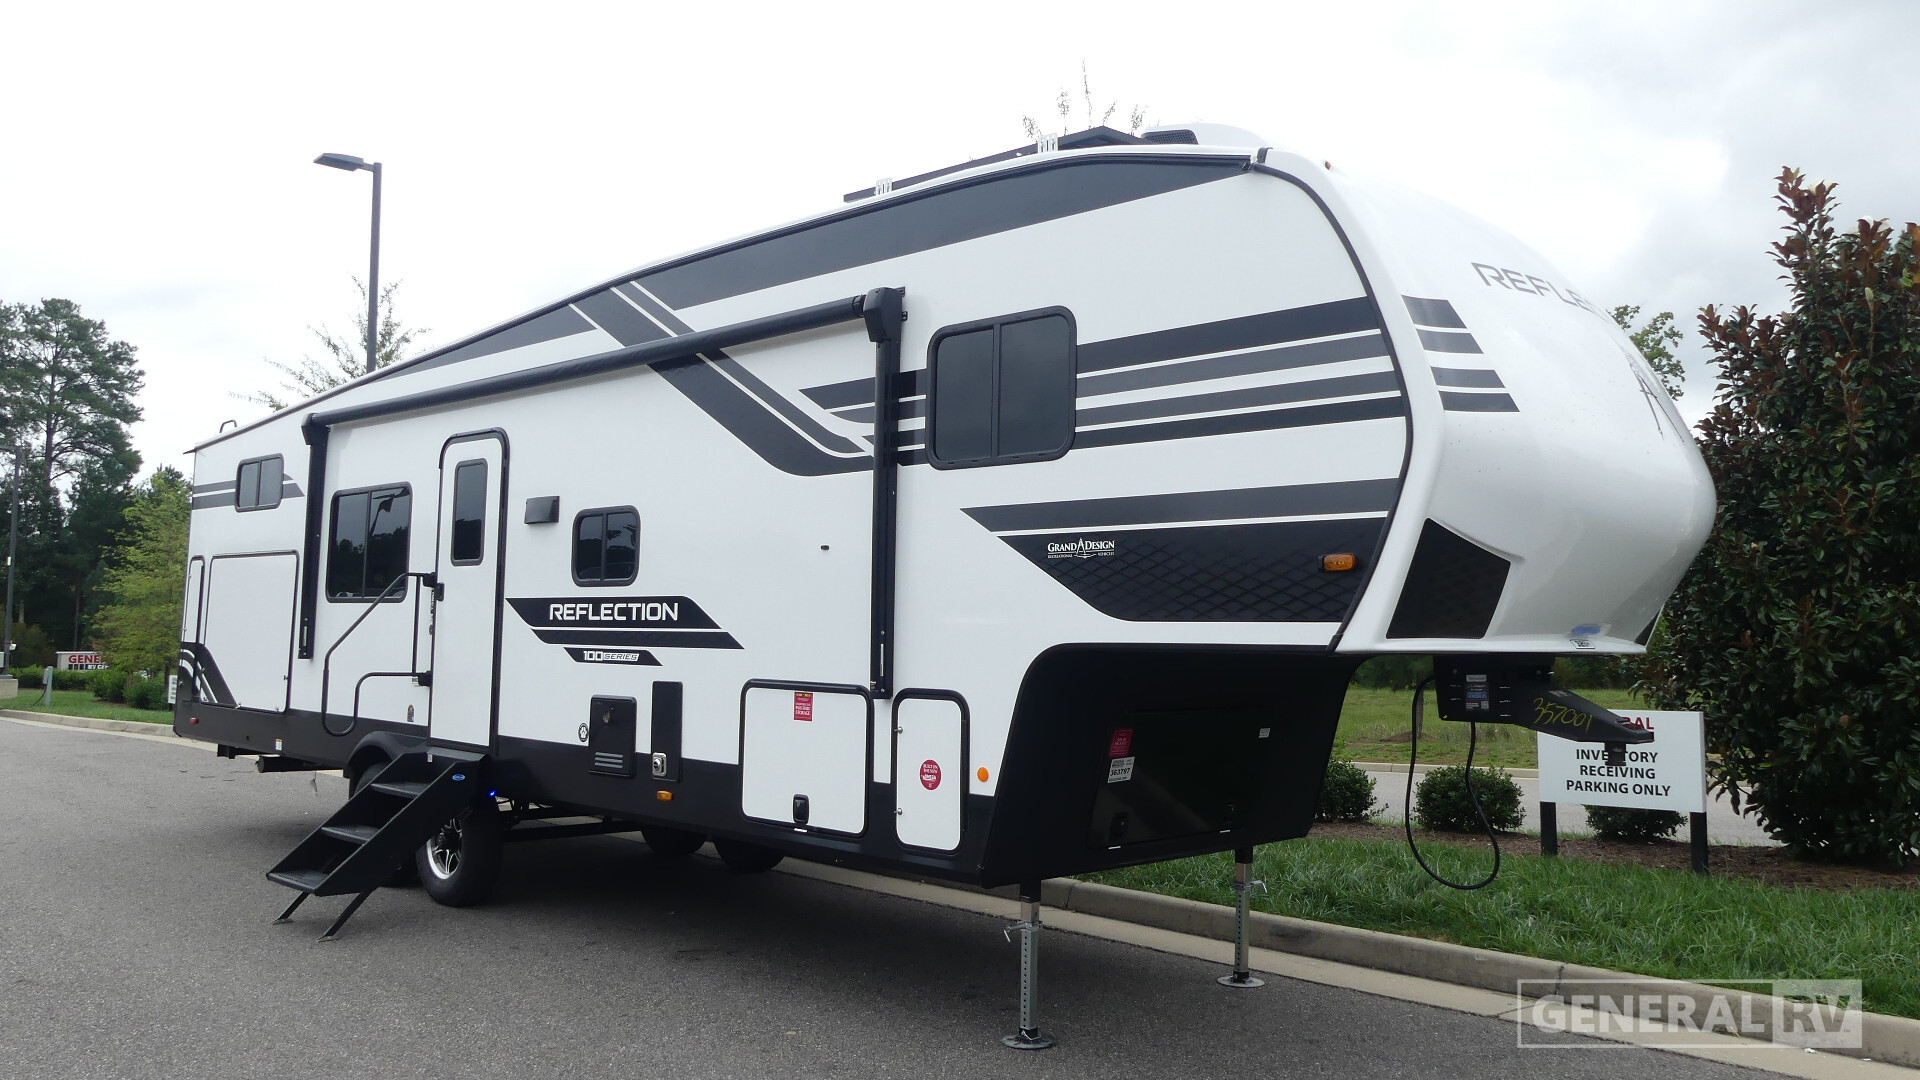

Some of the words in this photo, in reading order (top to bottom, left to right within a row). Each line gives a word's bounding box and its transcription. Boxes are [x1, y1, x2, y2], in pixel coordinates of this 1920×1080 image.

[1047, 542, 1077, 552] GRAND
[1084, 540, 1115, 550] DESIGN
[549, 602, 679, 621] REFLECTION
[68, 654, 103, 664] GENE
[583, 650, 604, 661] 100
[604, 653, 639, 662] SERIES
[1534, 697, 1593, 734] 357001
[1576, 749, 1659, 763] INVETORY
[1579, 764, 1656, 780] RECEIVING
[1566, 779, 1629, 794] PARKING
[1632, 783, 1671, 797] ONLY
